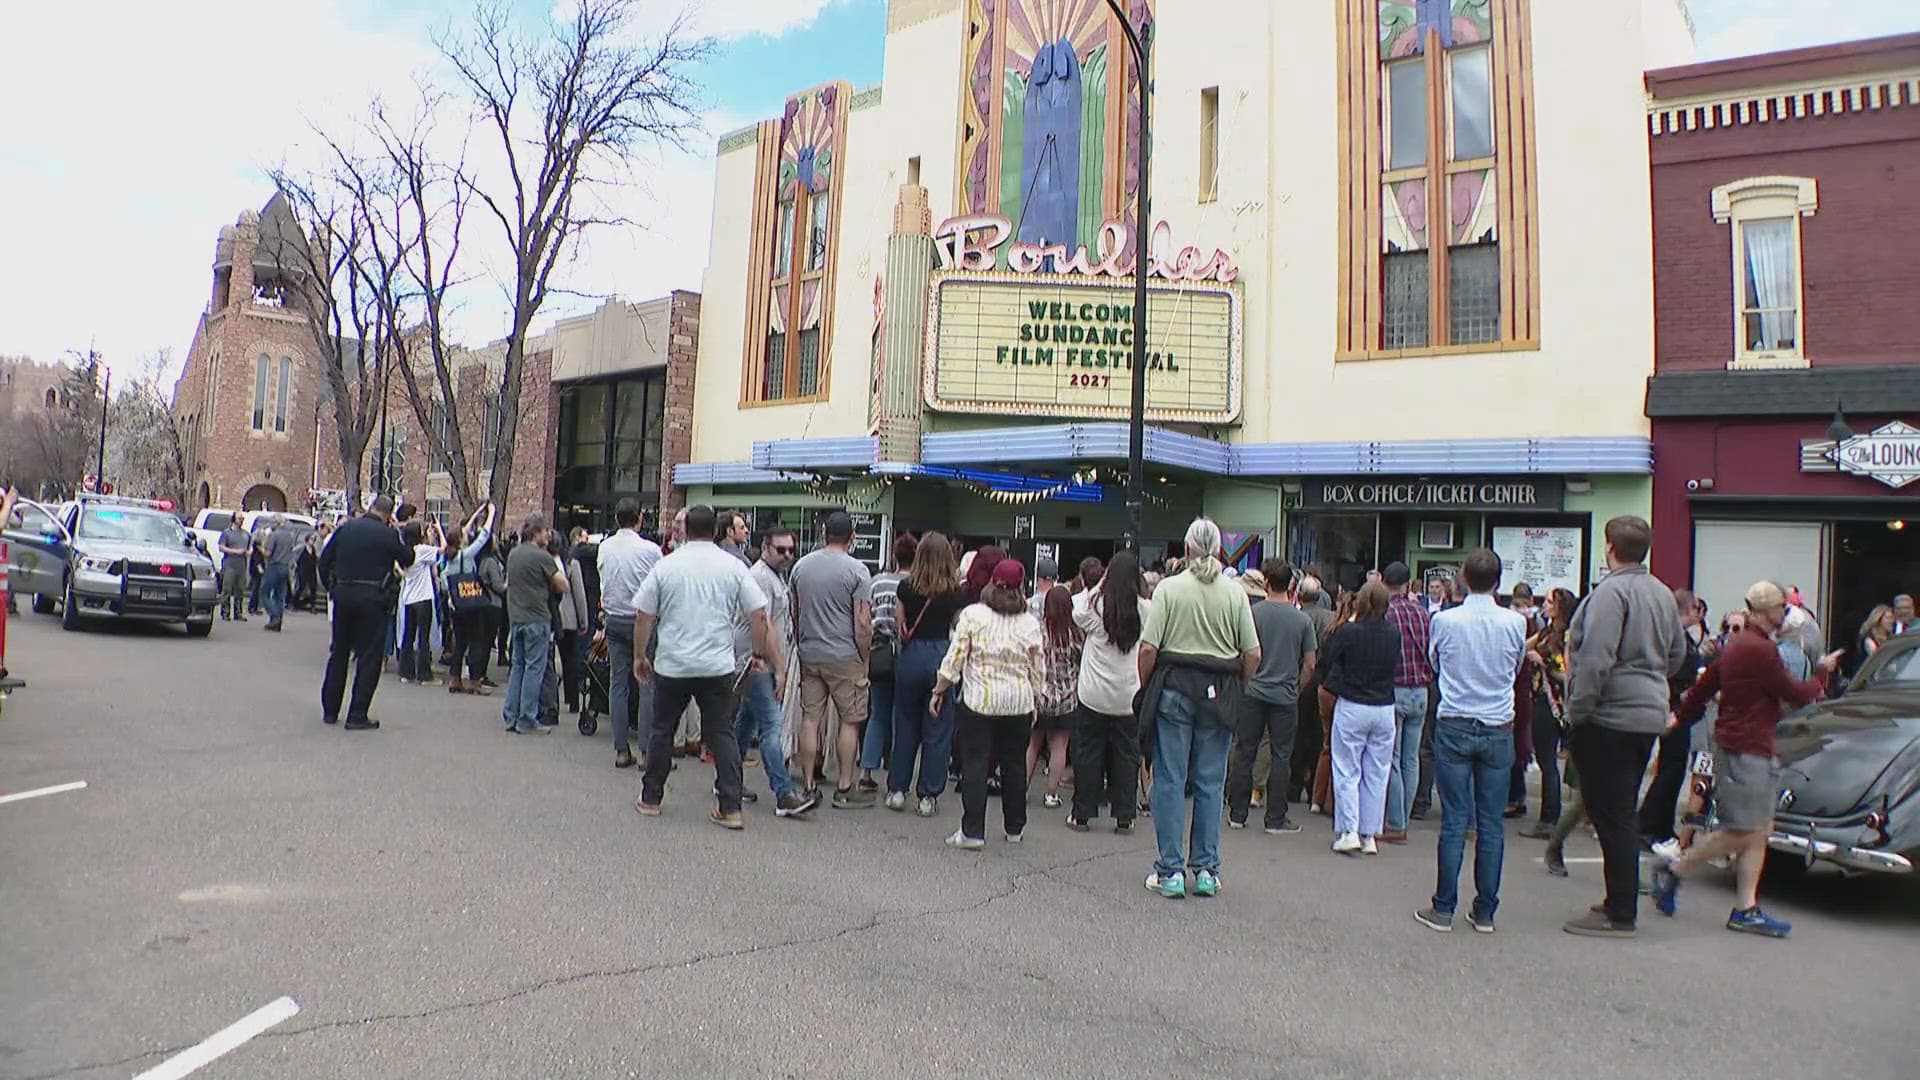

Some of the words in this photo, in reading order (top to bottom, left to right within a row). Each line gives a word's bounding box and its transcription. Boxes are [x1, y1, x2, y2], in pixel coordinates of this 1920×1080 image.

[1028, 300, 1136, 324] WELCOM
[996, 345, 1053, 366] FILM
[1070, 373, 1111, 388] 2027
[1323, 485, 1354, 503] BOX
[1480, 484, 1536, 504] CENTER
